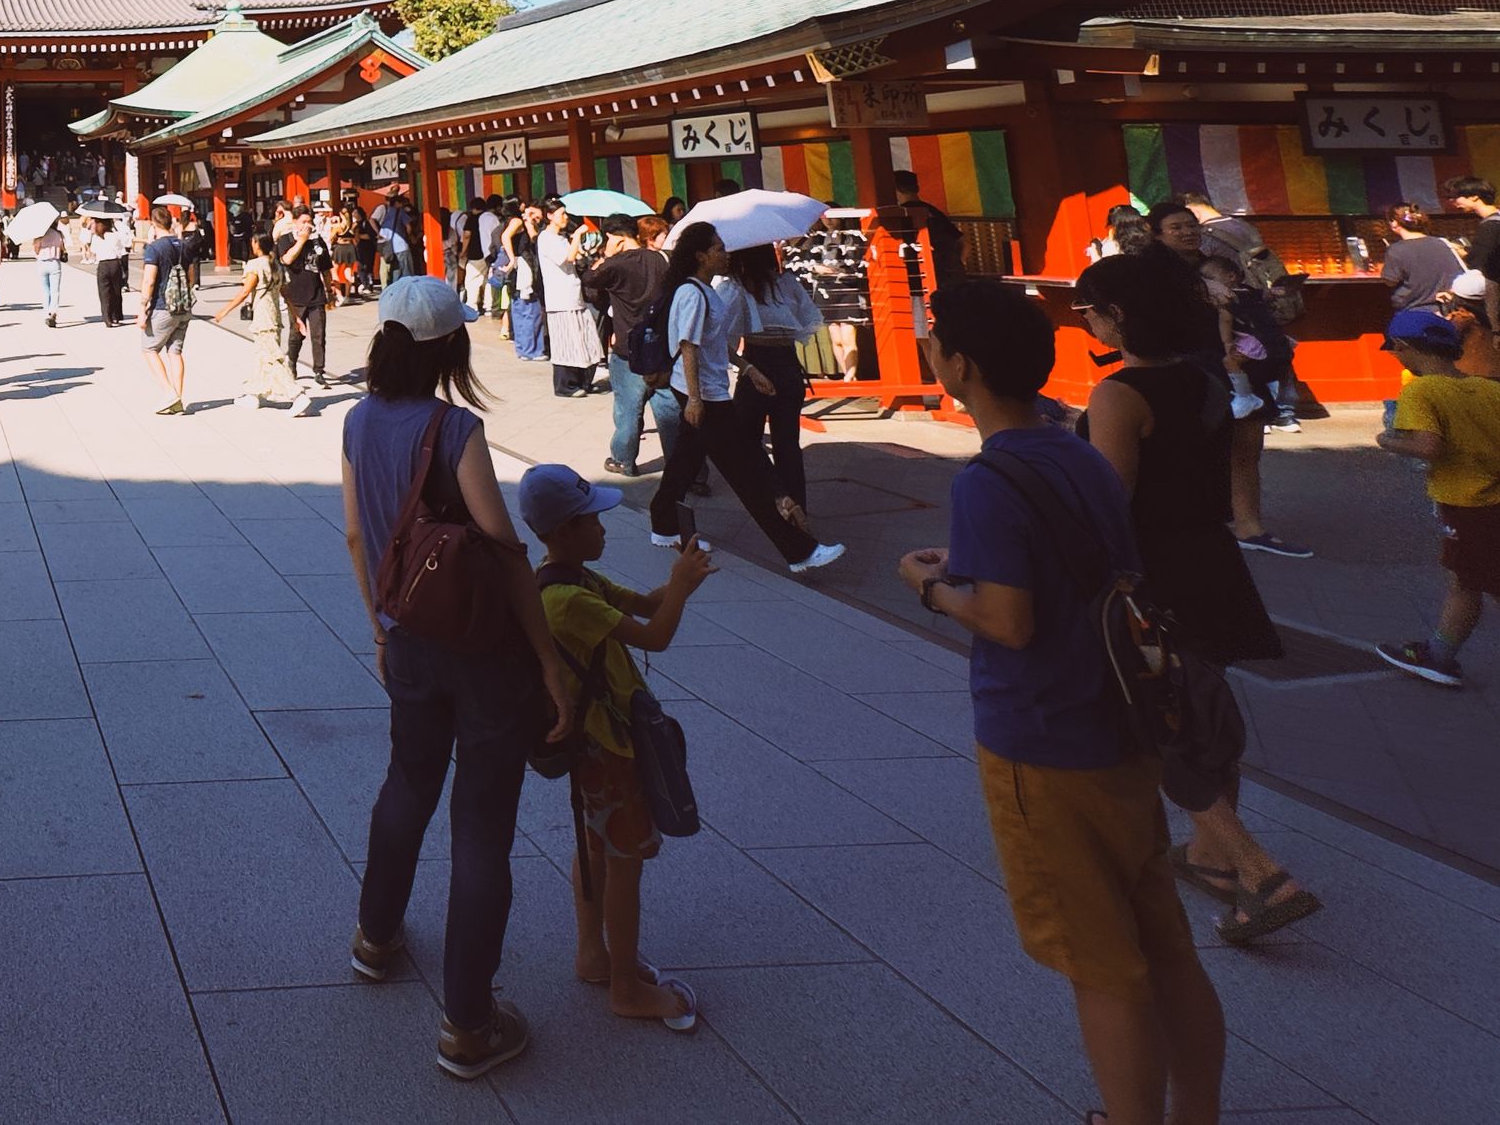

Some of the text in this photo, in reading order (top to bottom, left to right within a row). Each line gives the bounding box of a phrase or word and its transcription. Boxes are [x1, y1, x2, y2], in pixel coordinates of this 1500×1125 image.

[682, 117, 748, 152] みくじ
[1317, 105, 1431, 138] みくじ
[488, 141, 523, 166] みくじ
